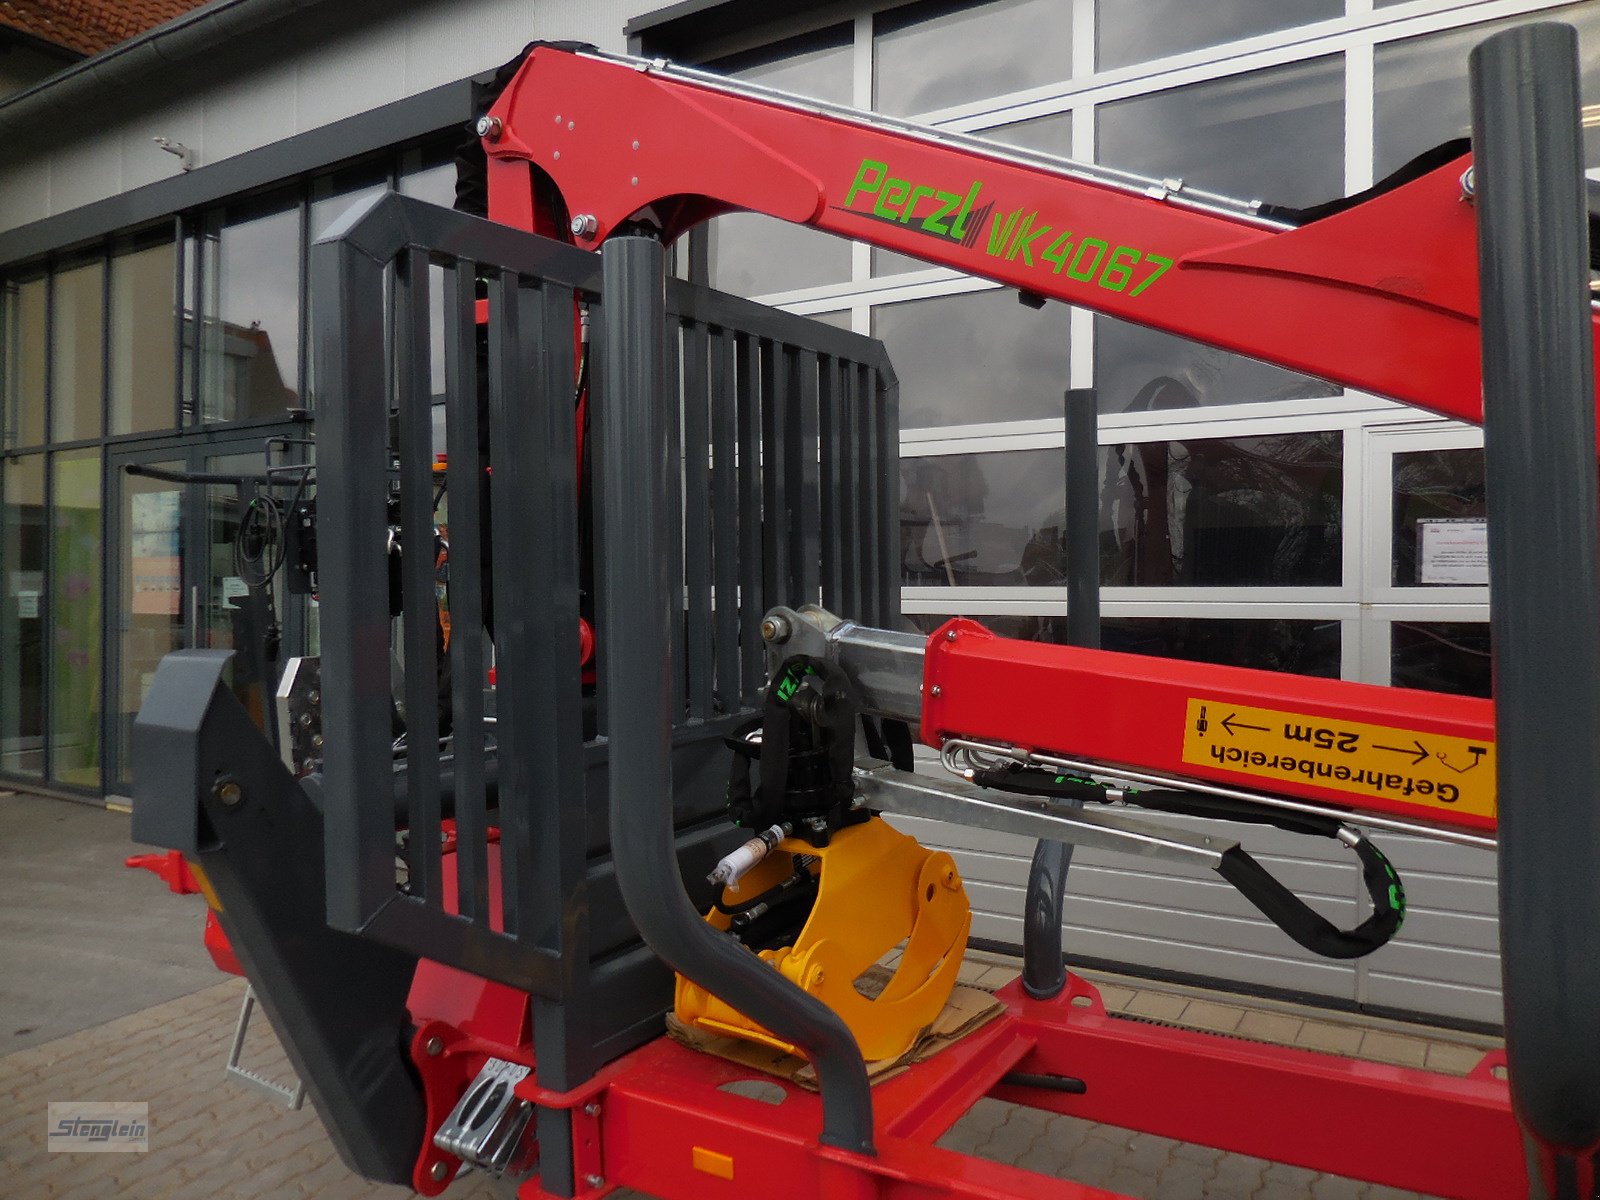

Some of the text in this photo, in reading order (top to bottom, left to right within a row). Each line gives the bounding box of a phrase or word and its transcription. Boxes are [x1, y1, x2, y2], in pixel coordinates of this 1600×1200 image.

[844, 159, 982, 240] Perzl
[1284, 723, 1360, 753] 25m
[1210, 744, 1460, 803] Gefahrenbereich
